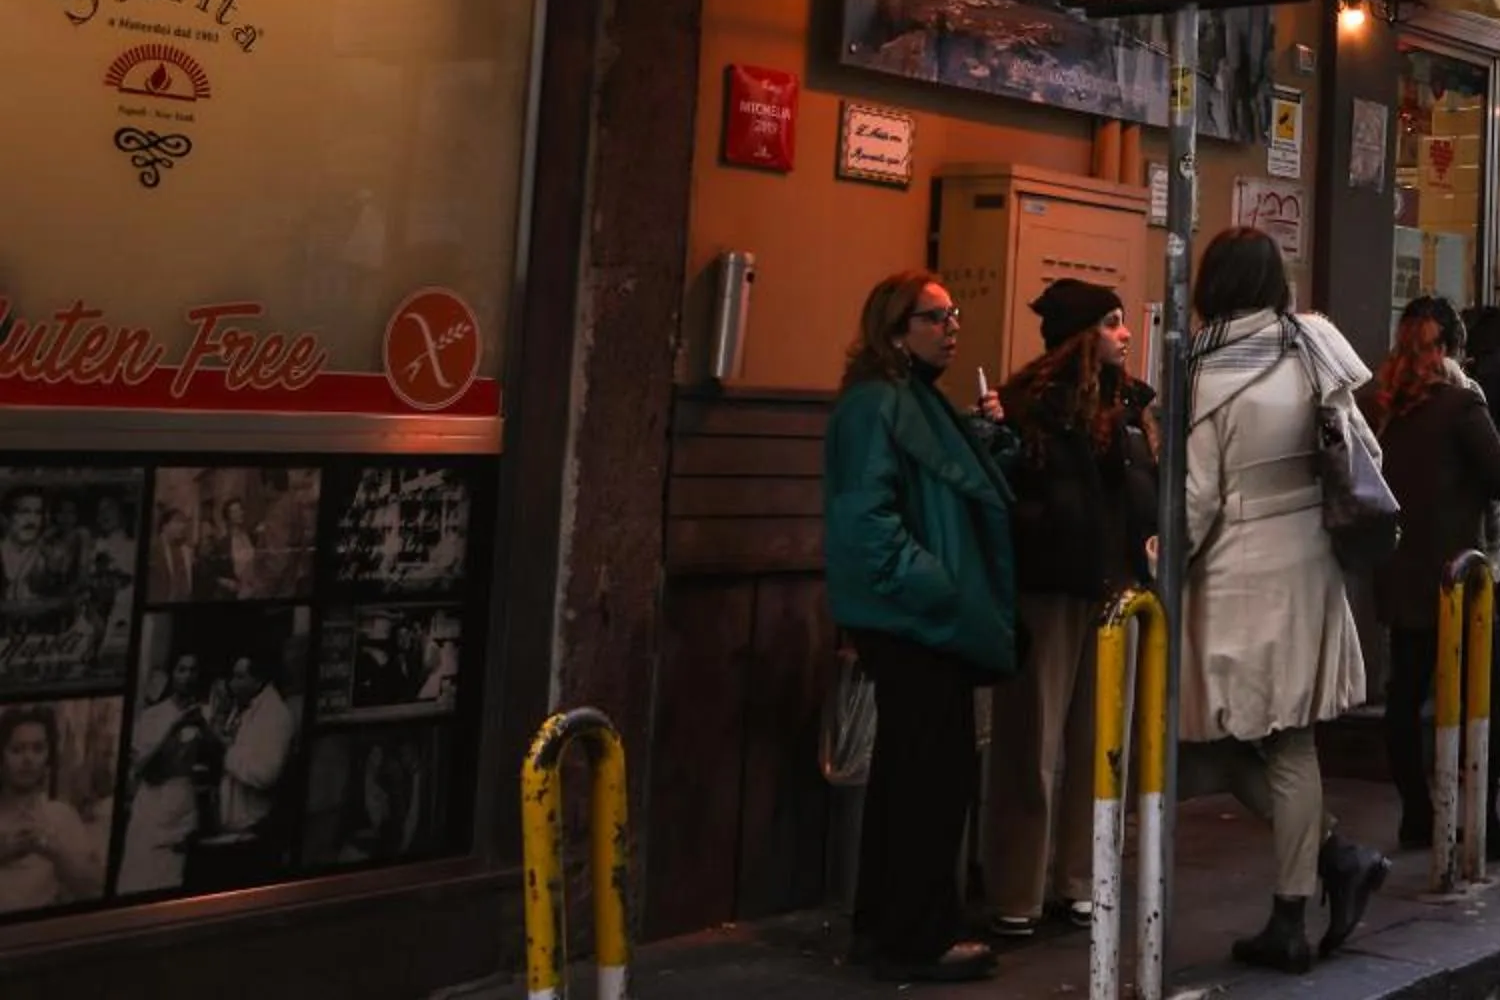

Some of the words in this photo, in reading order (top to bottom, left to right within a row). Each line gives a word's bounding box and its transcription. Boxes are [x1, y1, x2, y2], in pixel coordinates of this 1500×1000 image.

[740, 100, 791, 121] MICHELIN
[0, 298, 165, 385] uten
[170, 302, 327, 398] Free
